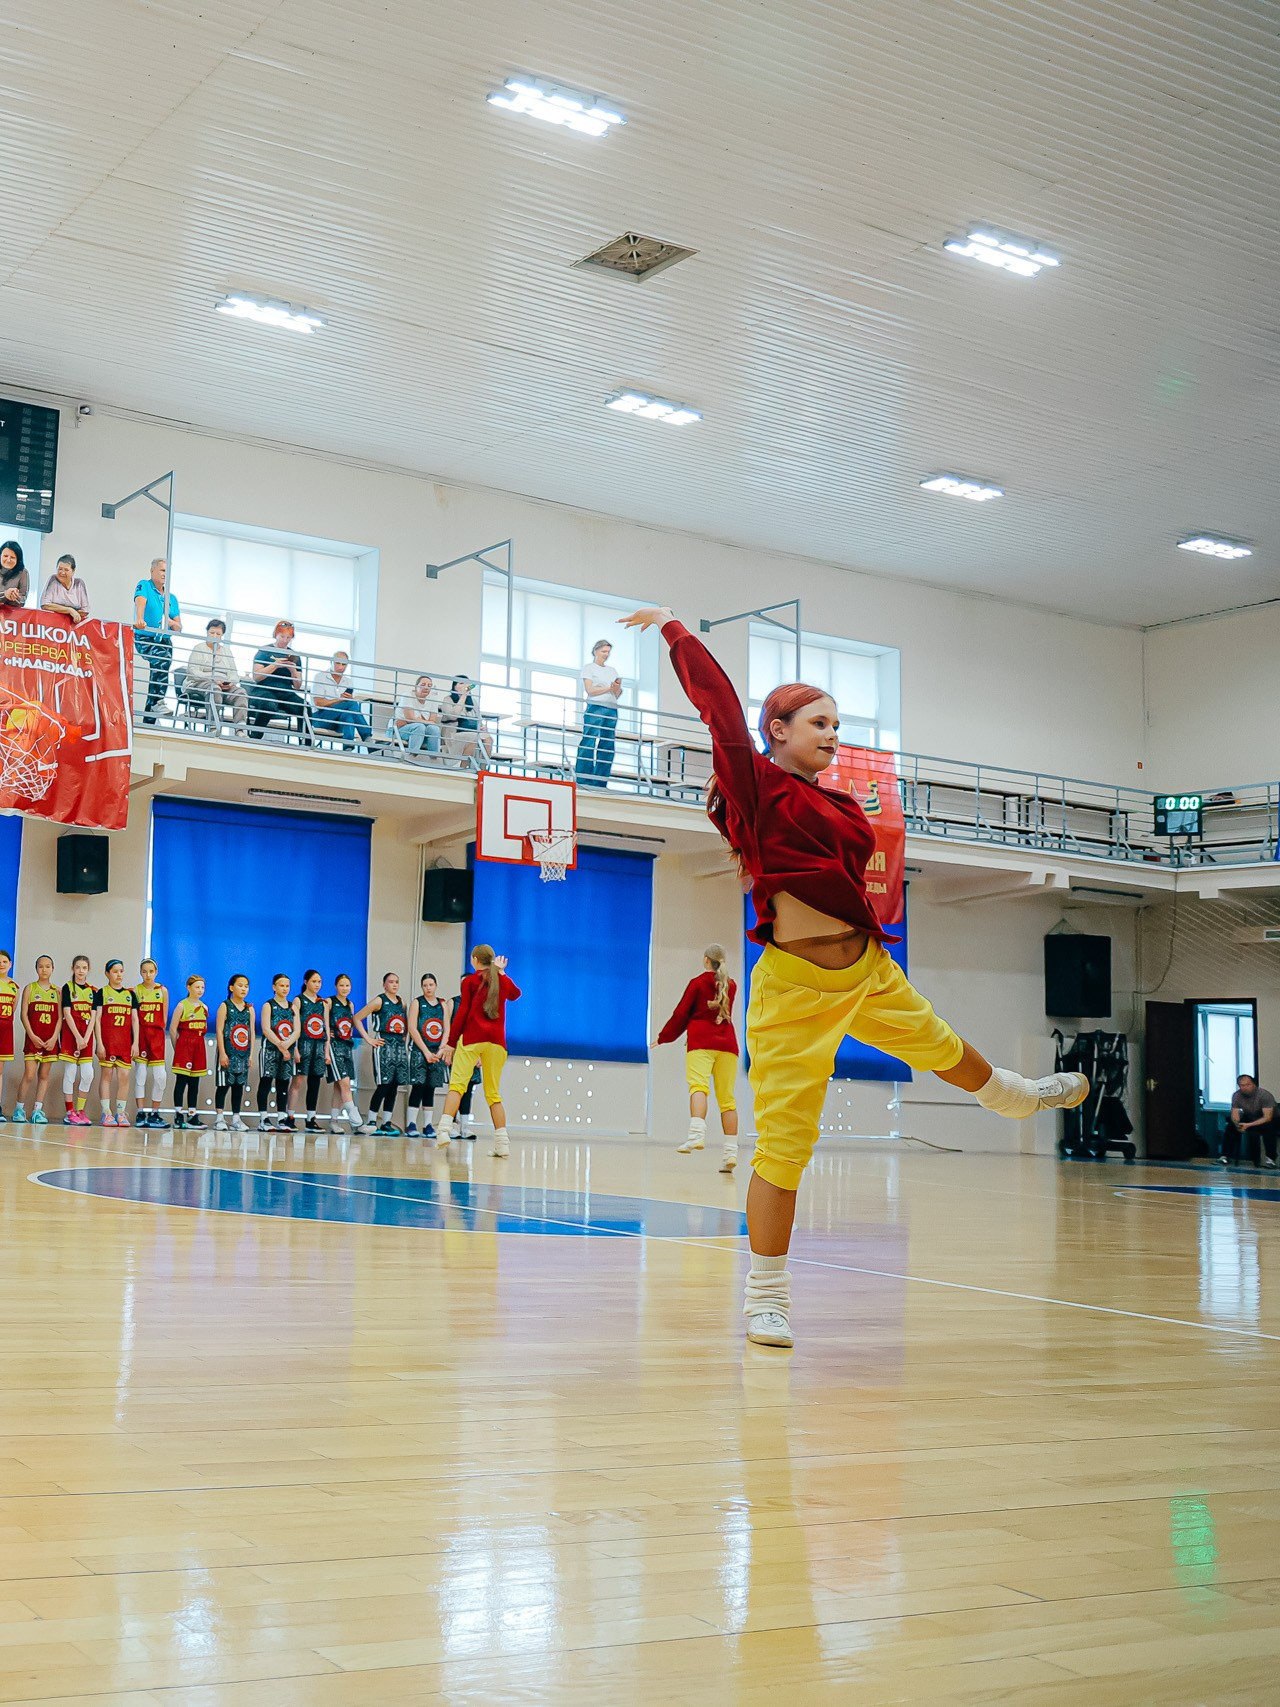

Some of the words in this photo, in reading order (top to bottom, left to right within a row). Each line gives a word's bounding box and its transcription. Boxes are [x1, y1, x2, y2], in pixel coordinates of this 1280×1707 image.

[21, 622, 91, 650] ШКОЛА
[4, 640, 69, 661] РЕЗЕРВА
[84, 652, 93, 665] 5
[4, 656, 93, 679] «НАДЕЖДА»
[1, 1005, 13, 1016] 29
[107, 1006, 127, 1016] СШОР
[39, 1013, 52, 1024] 43
[114, 1015, 125, 1027] 27
[143, 1012, 155, 1023] 41
